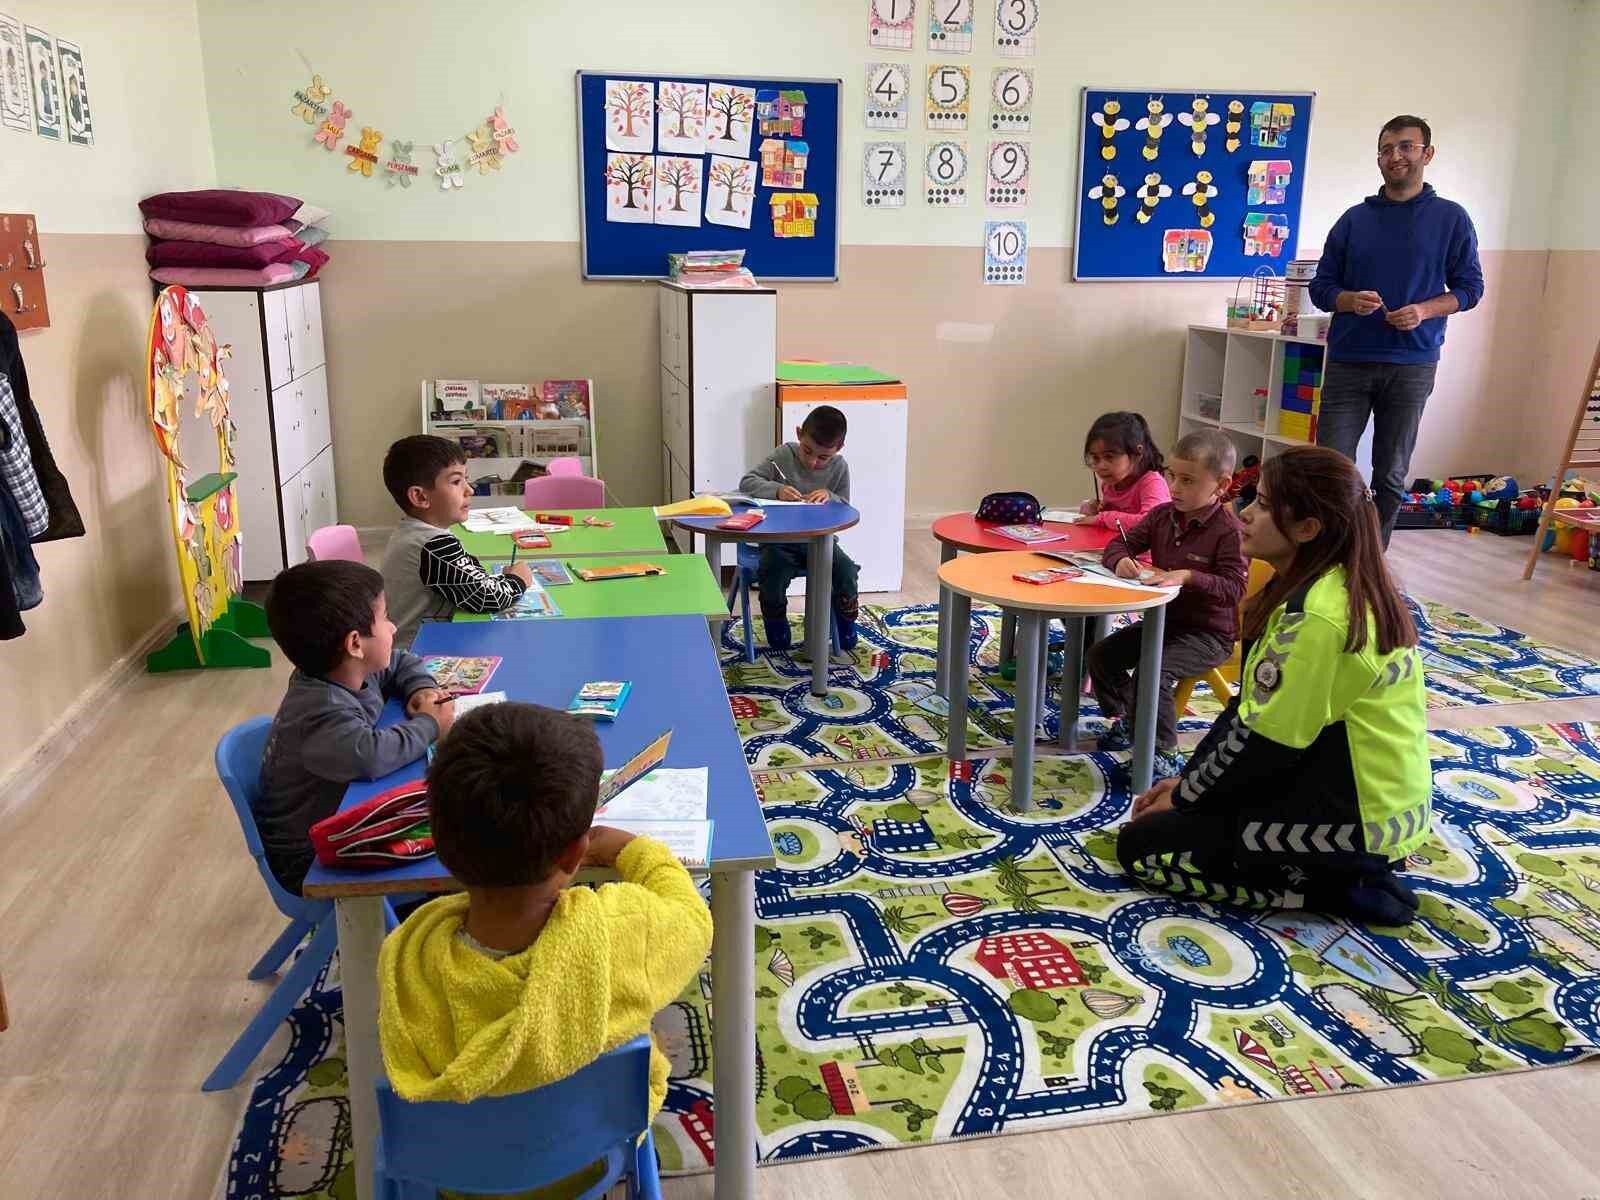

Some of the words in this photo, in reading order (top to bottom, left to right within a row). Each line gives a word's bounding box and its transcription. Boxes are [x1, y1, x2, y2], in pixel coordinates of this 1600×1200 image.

[943, 0, 961, 25] 2
[1008, 0, 1026, 31] 3
[874, 69, 898, 102] 4
[940, 70, 958, 103] 5
[1002, 74, 1020, 106] 6
[878, 150, 894, 182] 7
[937, 147, 954, 180] 8
[1000, 147, 1018, 179] 9
[993, 231, 1019, 256] 10
